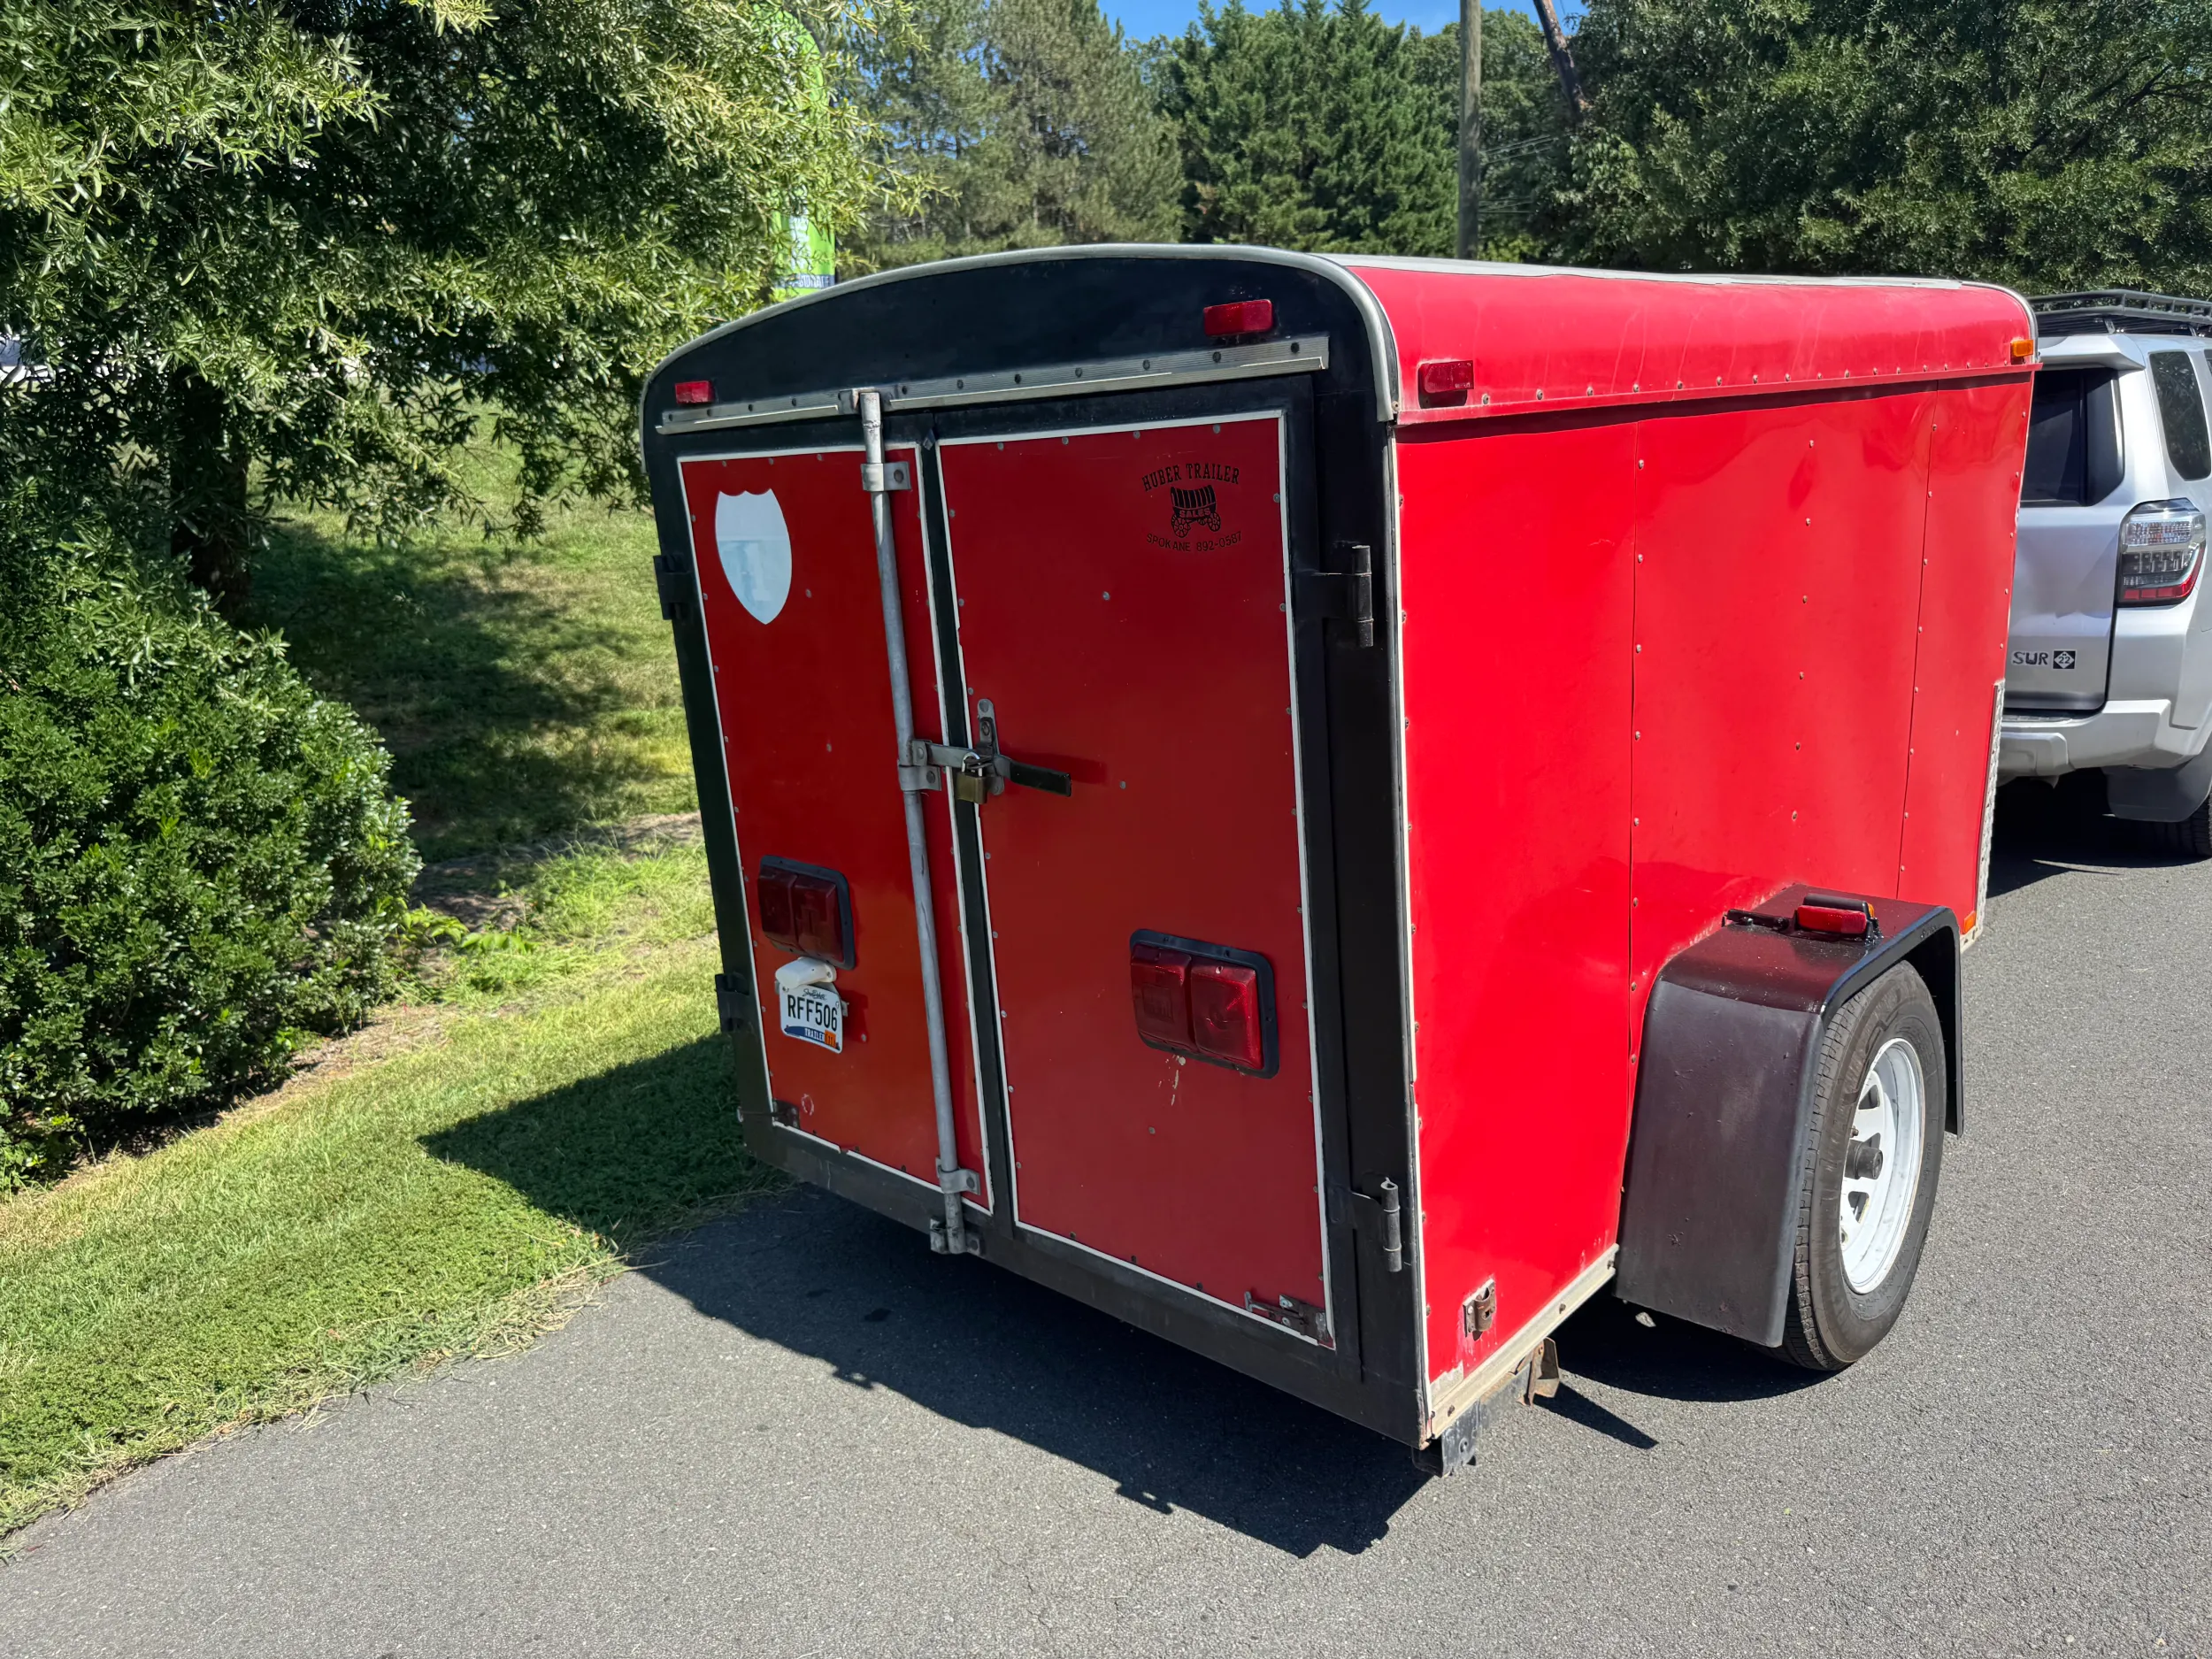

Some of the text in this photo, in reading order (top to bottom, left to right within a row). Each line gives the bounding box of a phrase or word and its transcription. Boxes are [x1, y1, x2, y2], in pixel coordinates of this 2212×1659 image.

[1142, 463, 1240, 492] HUBER TRAILER
[1179, 508, 1211, 518] SALES
[1147, 531, 1242, 551] SPOKANE 892-0587
[787, 995, 838, 1032] RFF506
